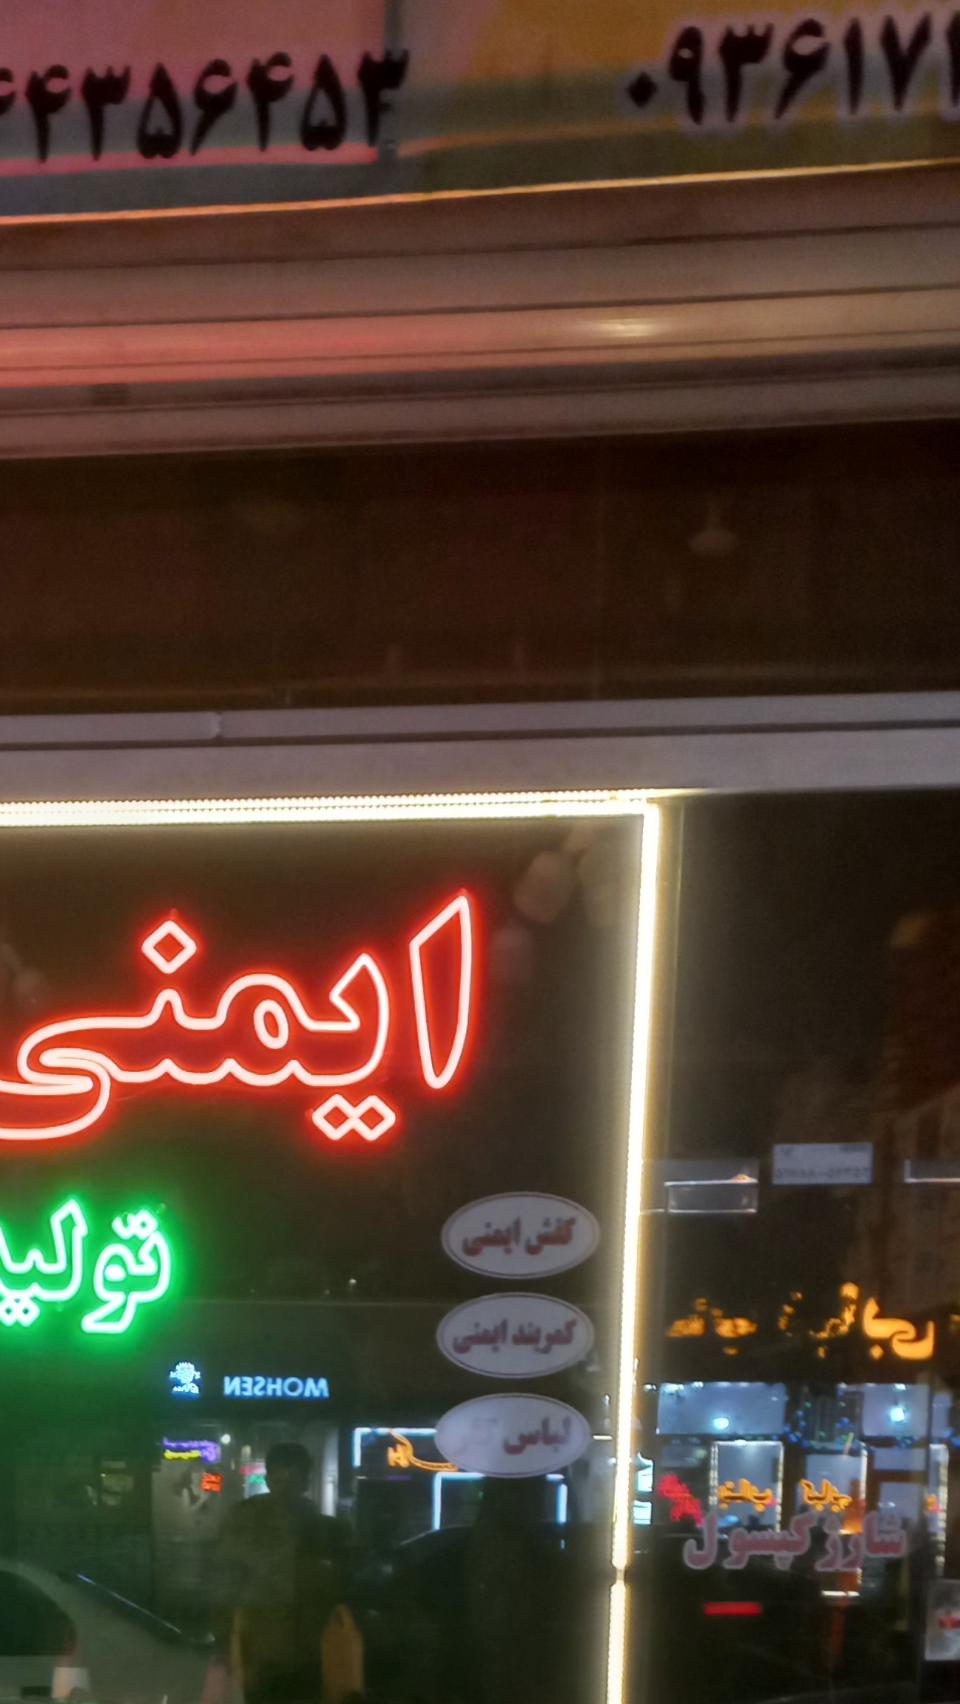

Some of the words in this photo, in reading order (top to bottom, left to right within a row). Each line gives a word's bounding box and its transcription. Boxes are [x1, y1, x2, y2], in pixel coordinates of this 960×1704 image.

[626, 9, 960, 125] ۰۹۳۶۱۷
[462, 1216, 521, 1257] ایمنی
[525, 1216, 576, 1256] کفش
[453, 1319, 508, 1354] ایمنی
[511, 1318, 577, 1354] کمربند
[503, 1416, 572, 1455] لباس
